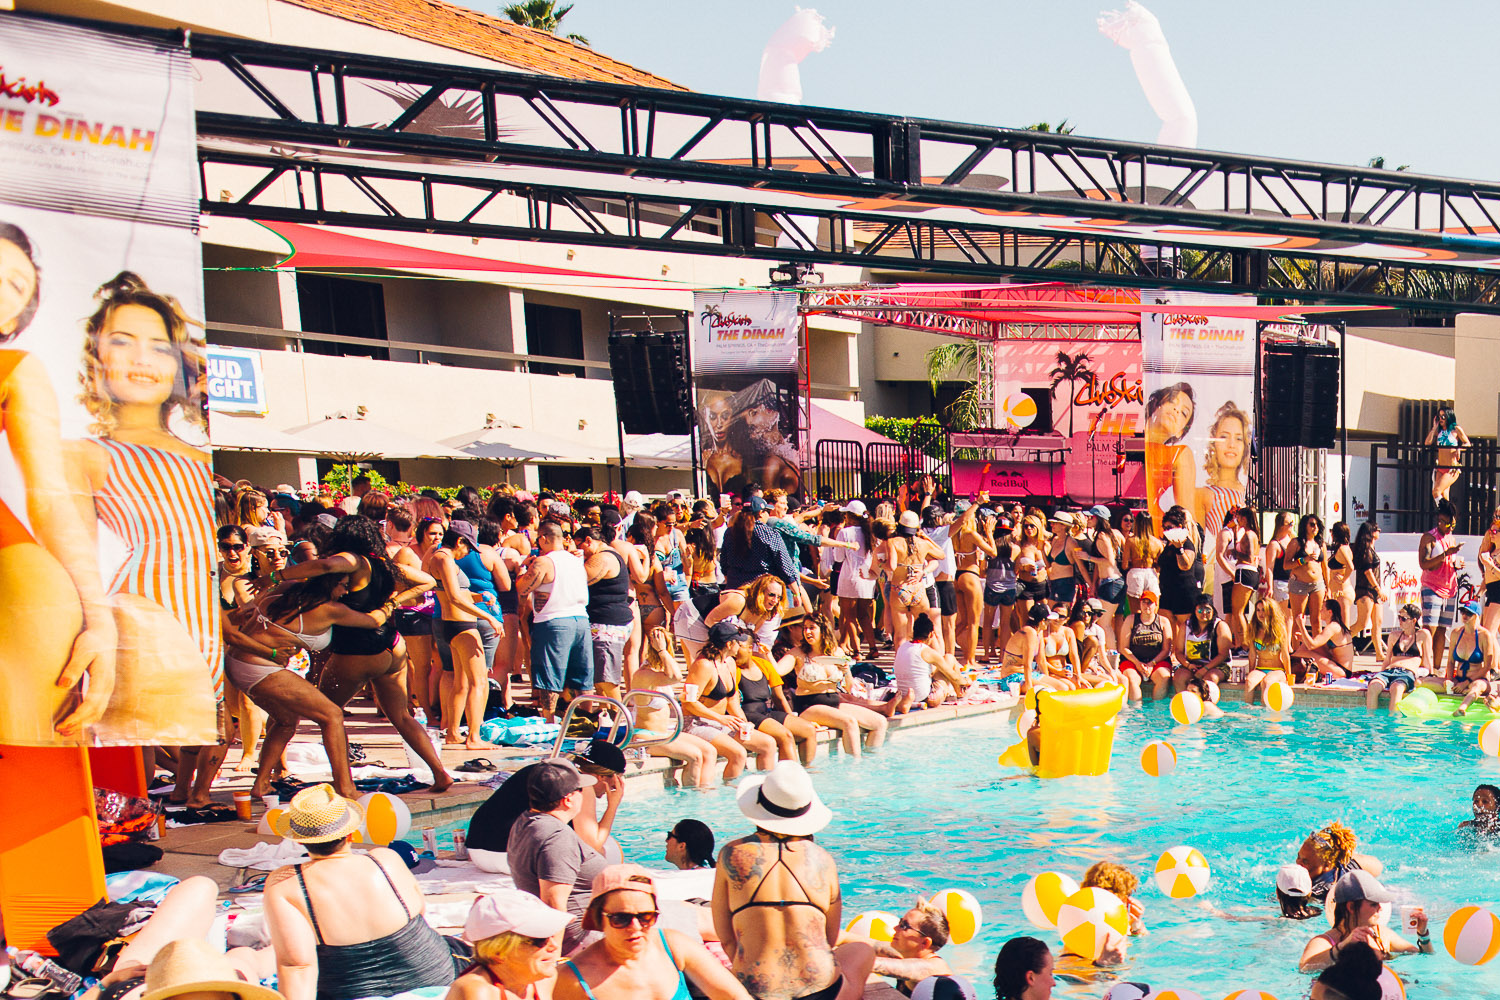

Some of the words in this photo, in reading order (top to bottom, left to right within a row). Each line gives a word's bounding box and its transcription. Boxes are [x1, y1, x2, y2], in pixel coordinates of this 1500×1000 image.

[34, 113, 155, 152] DINAH
[717, 329, 740, 341] THE
[742, 328, 785, 340] DINAH
[1170, 328, 1195, 340] THE
[1198, 329, 1245, 341] DINAH
[1088, 412, 1139, 436] THE
[1086, 443, 1110, 452] PALM
[1011, 480, 1029, 488] Bull
